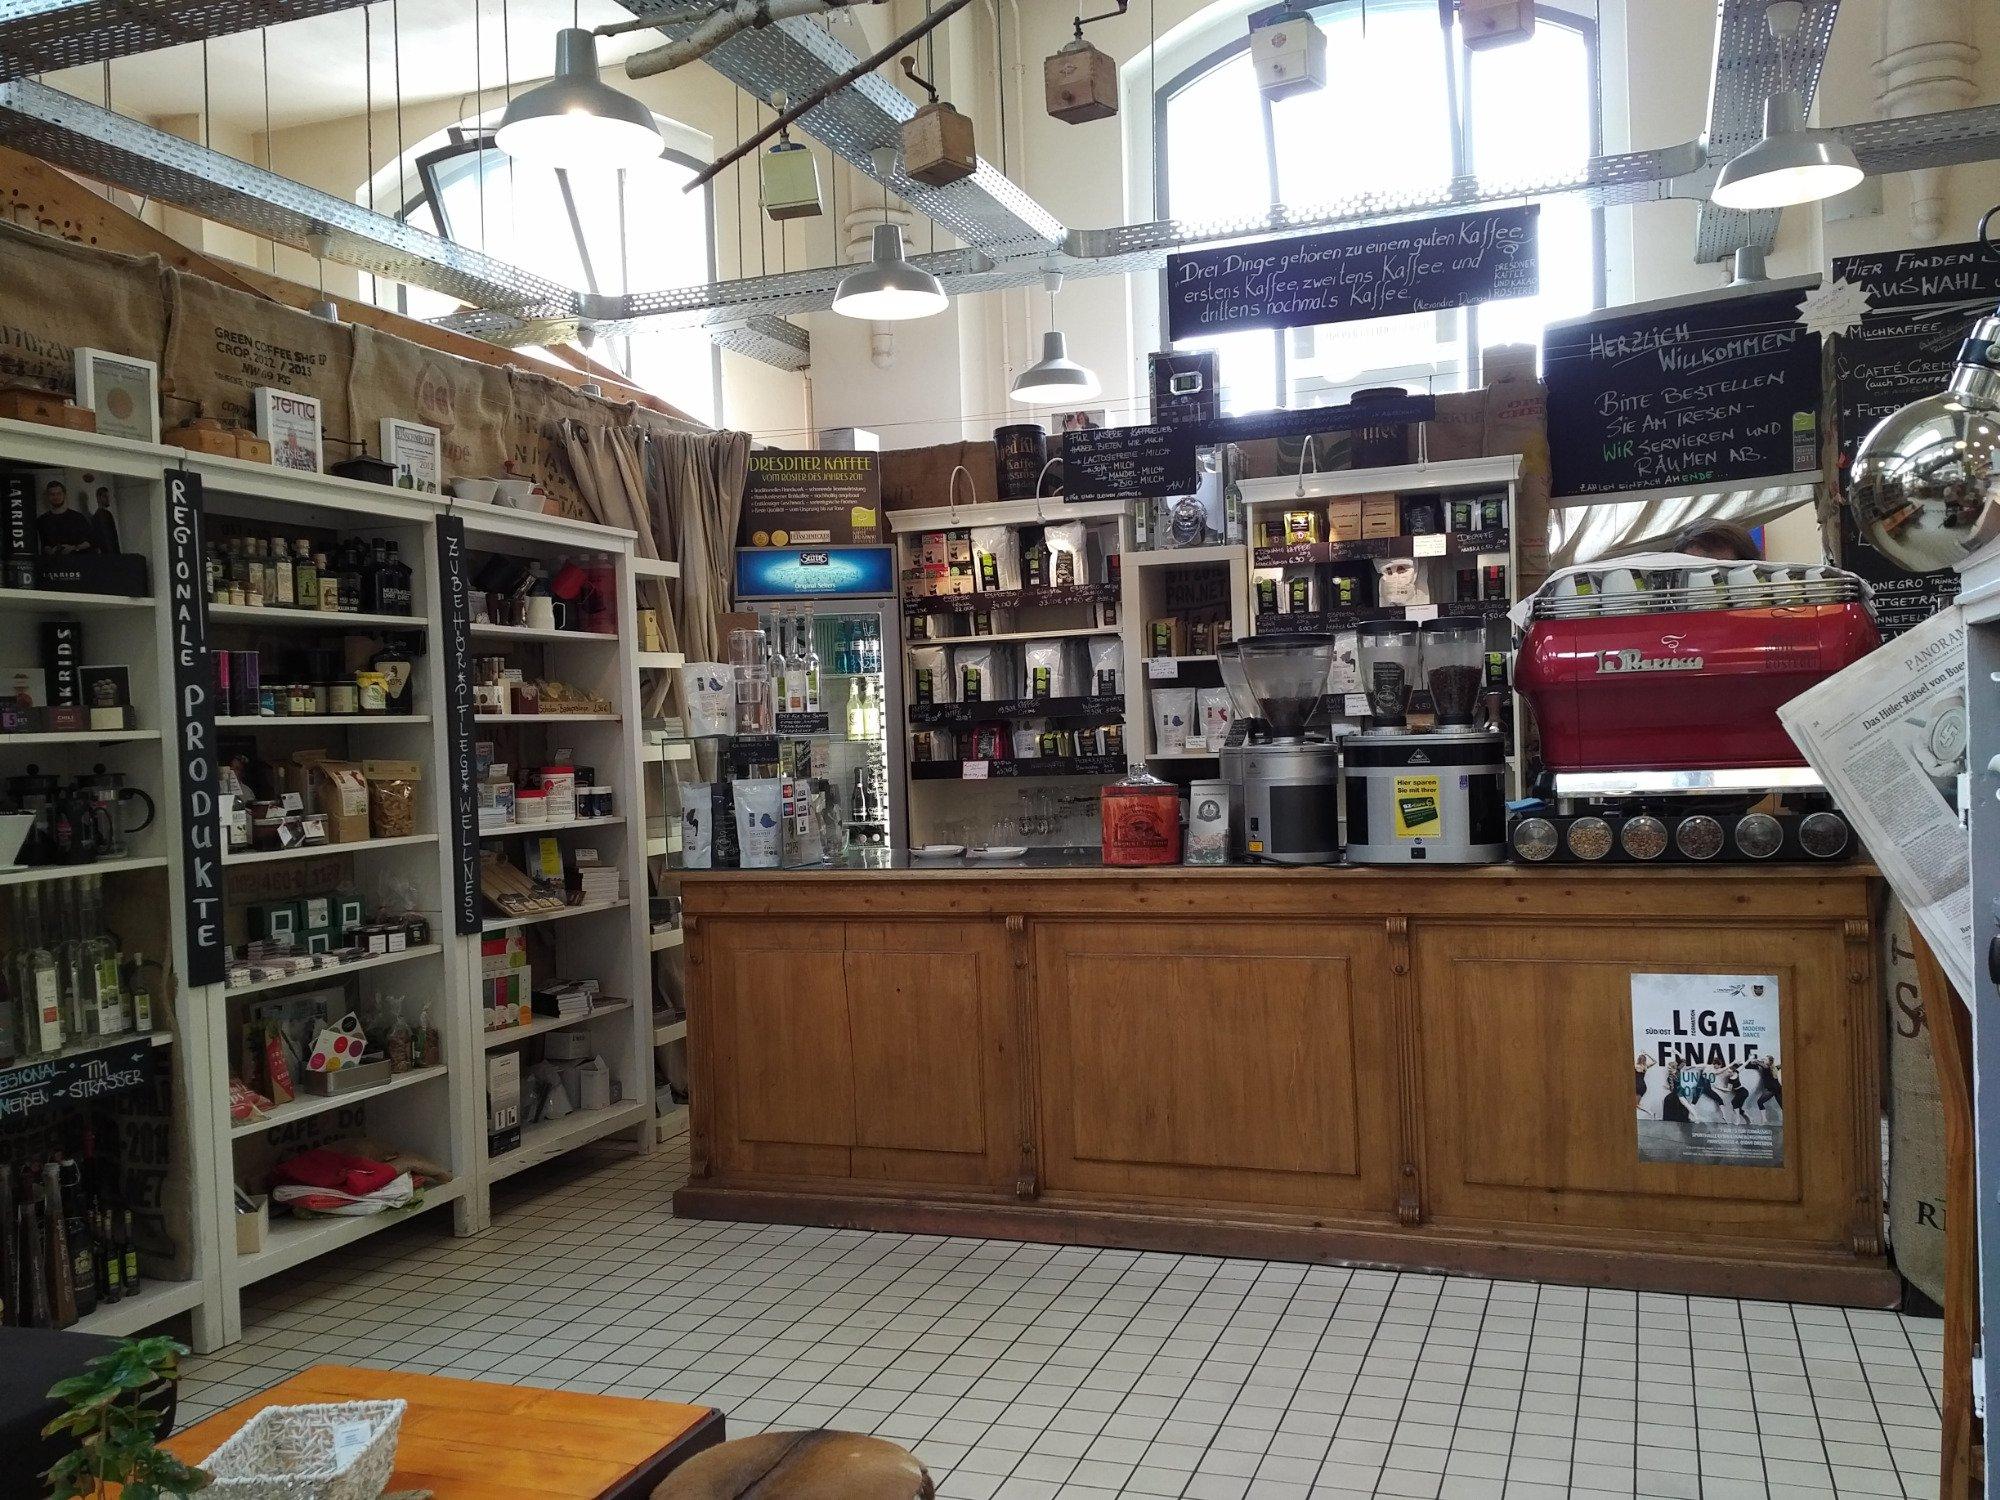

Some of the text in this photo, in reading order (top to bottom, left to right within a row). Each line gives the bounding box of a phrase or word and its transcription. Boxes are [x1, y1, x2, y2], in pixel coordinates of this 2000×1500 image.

[1222, 254, 1276, 280] Dinge
[1280, 244, 1343, 272] gehören
[1345, 244, 1363, 258] zu
[1365, 238, 1411, 254] einem
[1413, 226, 1456, 256] guten
[1845, 257, 1883, 279] HIER
[1895, 253, 1974, 272] FINDEN
[1184, 281, 1241, 303] erstens
[1302, 265, 1374, 289] zweitens
[1452, 248, 1486, 271] und
[1865, 272, 1986, 298] AUSWAHL
[1200, 300, 1261, 325] drittens
[1266, 289, 1340, 317] nochmals
[214, 326, 252, 347] GREEN
[254, 339, 292, 362] COFFEE
[1850, 321, 1941, 341] MILCHKAFFEE
[1658, 331, 1797, 372] WILLKOMMEN
[1854, 362, 1902, 379] CAFFÉ
[1595, 370, 1785, 416] BITTE BESTELLEN
[1642, 416, 1667, 431] AM
[1603, 421, 1782, 463] WIR SERVIEREN UND
[750, 455, 872, 472] DRESDNER KAFFEE
[1633, 452, 1718, 477] RÄUMEN
[1681, 471, 1714, 482] ENDE
[10, 479, 24, 549] LAKRIDS
[1871, 578, 1925, 591] ONEGRO
[171, 479, 218, 948] REGIONALE PRODUKTE
[1862, 717, 1881, 732] Das
[1927, 673, 1947, 688] von
[0, 1061, 67, 1090] EGIONAL
[68, 1069, 145, 1098] STRASSER
